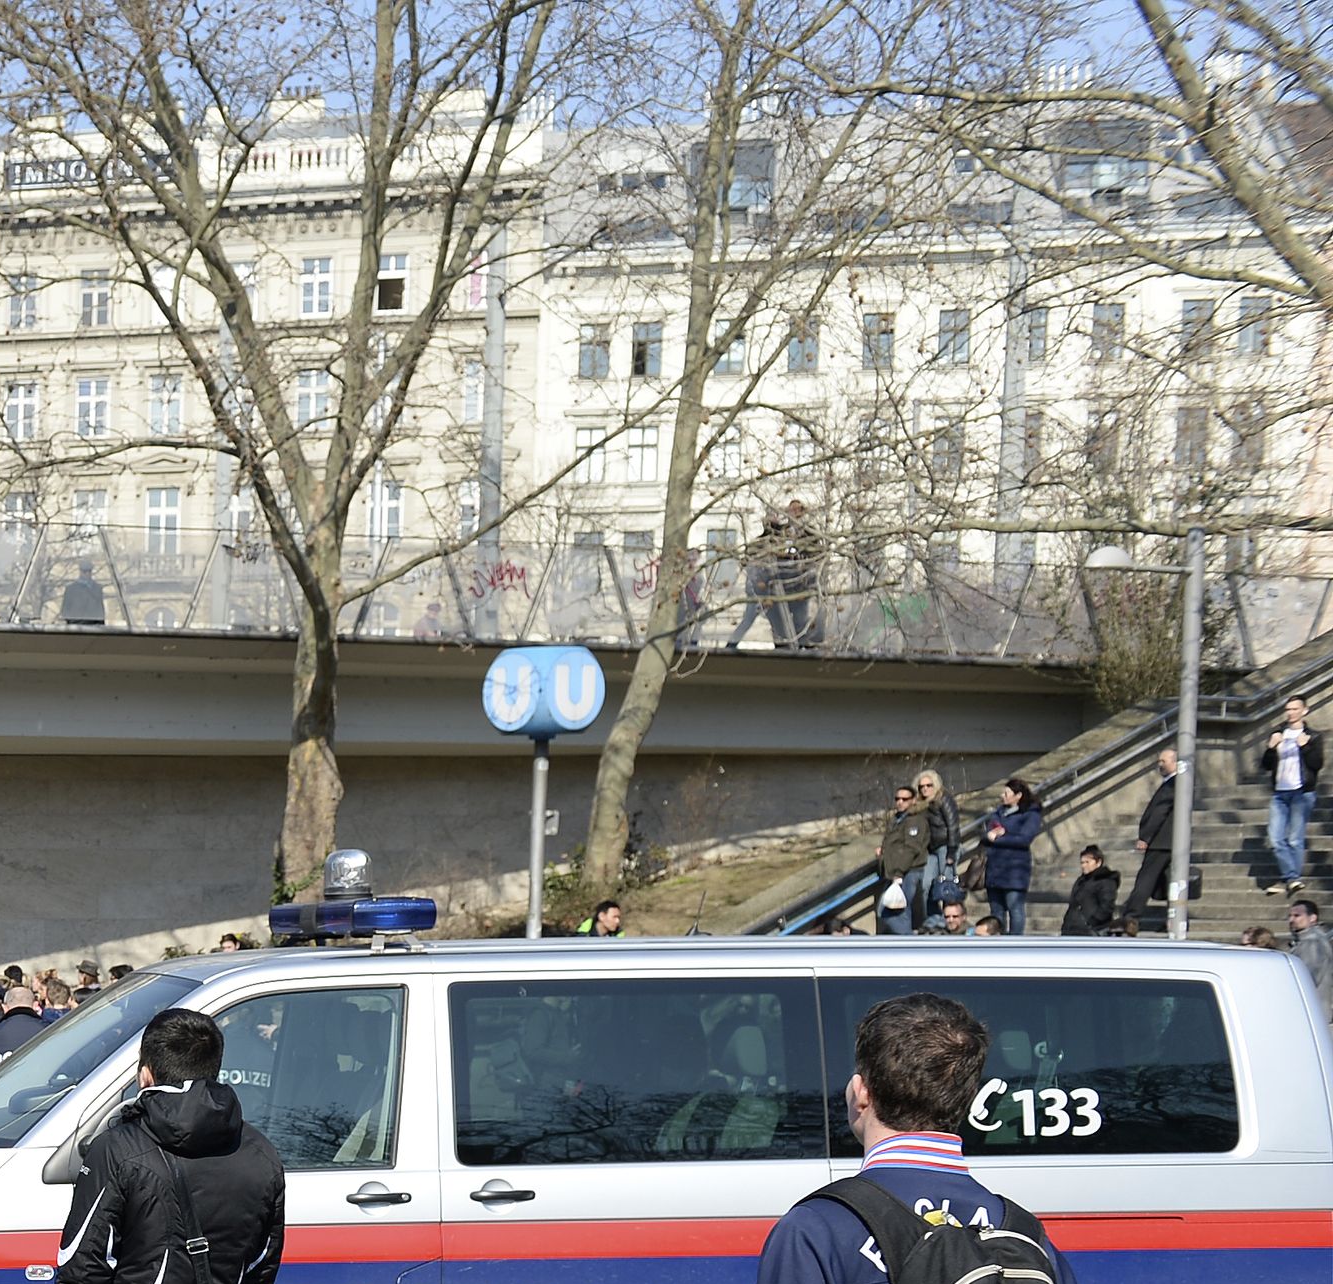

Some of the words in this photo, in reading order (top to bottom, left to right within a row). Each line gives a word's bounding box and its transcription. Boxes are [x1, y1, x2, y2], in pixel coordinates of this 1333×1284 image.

[555, 664, 596, 721] U
[217, 1069, 271, 1088] POLIZEI
[1012, 1088, 1102, 1137] 133
